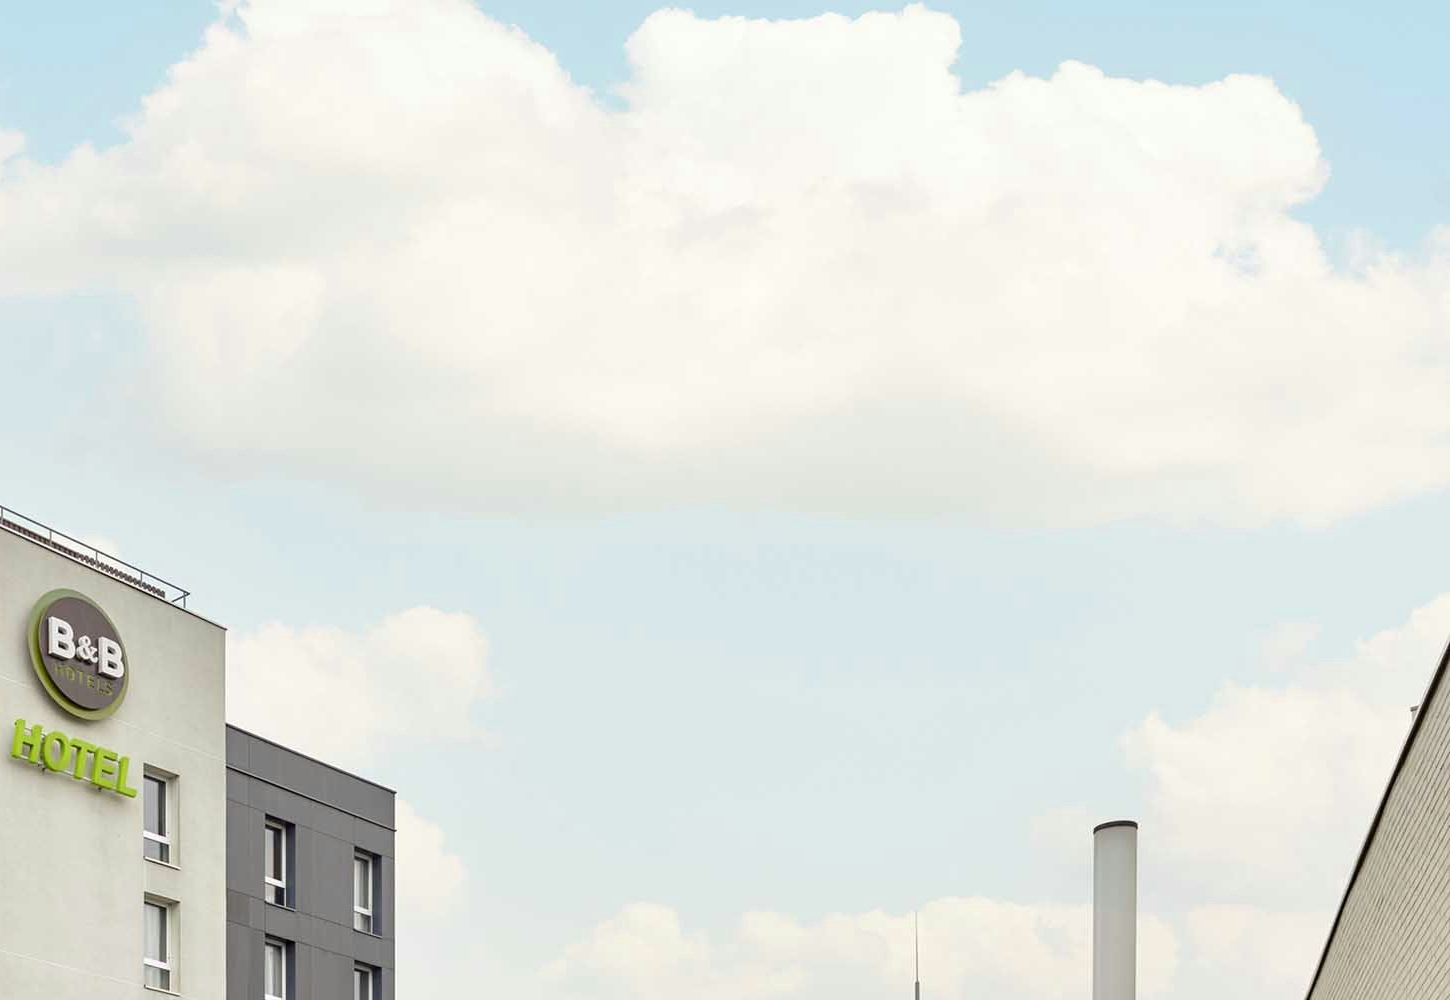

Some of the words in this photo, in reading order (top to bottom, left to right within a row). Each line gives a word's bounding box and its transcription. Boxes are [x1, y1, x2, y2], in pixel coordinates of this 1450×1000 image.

[48, 616, 124, 678] B&B
[54, 664, 113, 696] HOTELS
[11, 719, 137, 798] HOTEL
